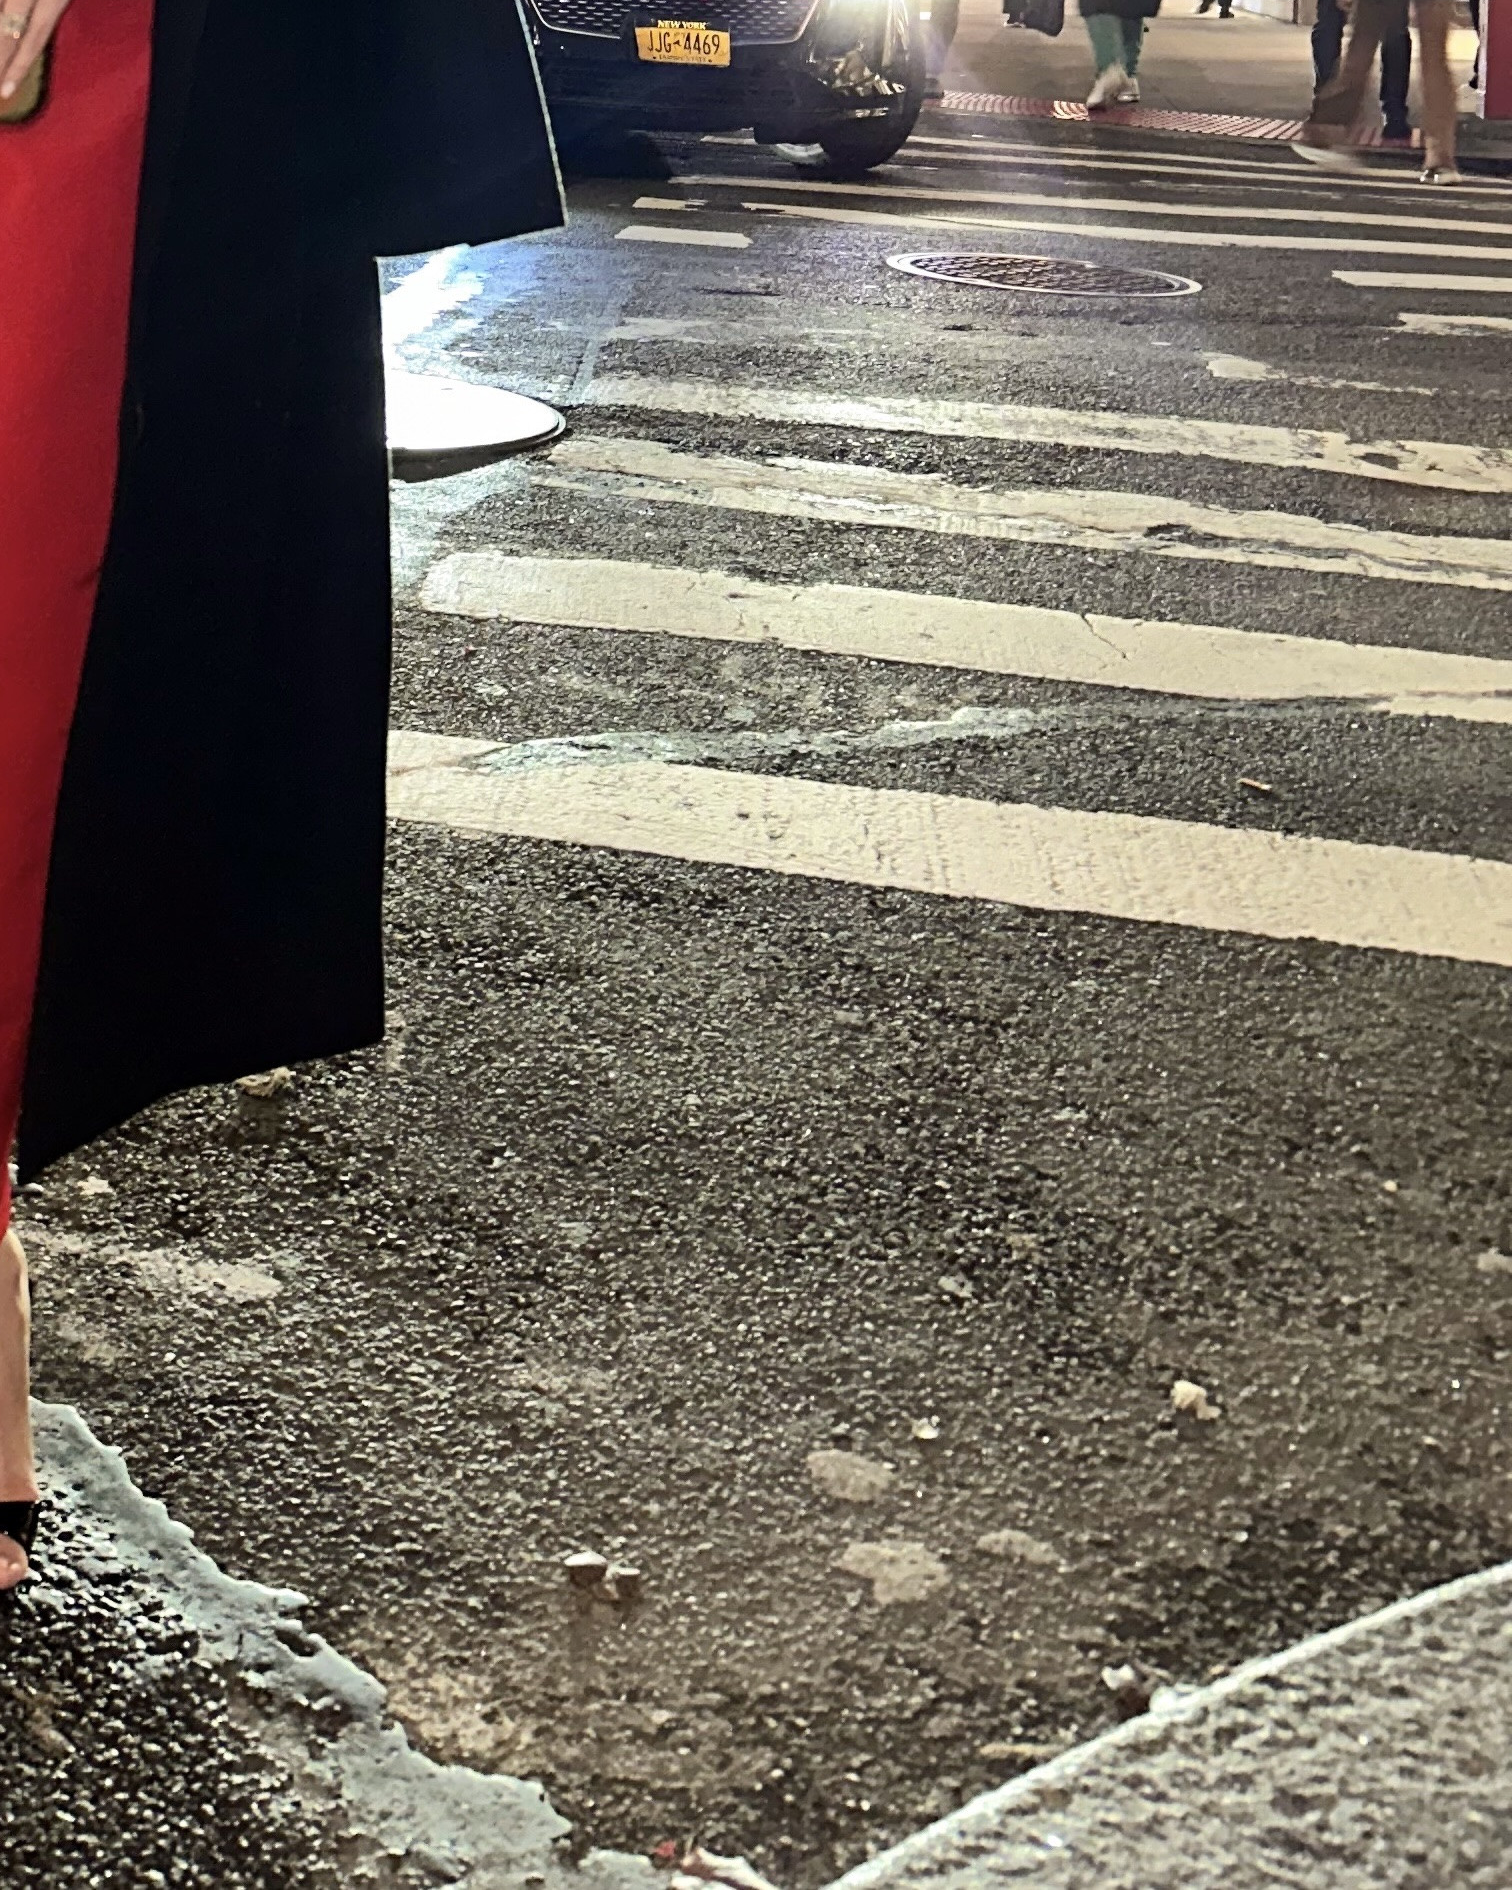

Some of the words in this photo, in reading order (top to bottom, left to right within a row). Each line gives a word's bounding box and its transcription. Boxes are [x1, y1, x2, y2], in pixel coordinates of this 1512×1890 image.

[657, 20, 681, 29] NEW
[681, 21, 706, 30] YORK
[684, 32, 720, 55] 4469
